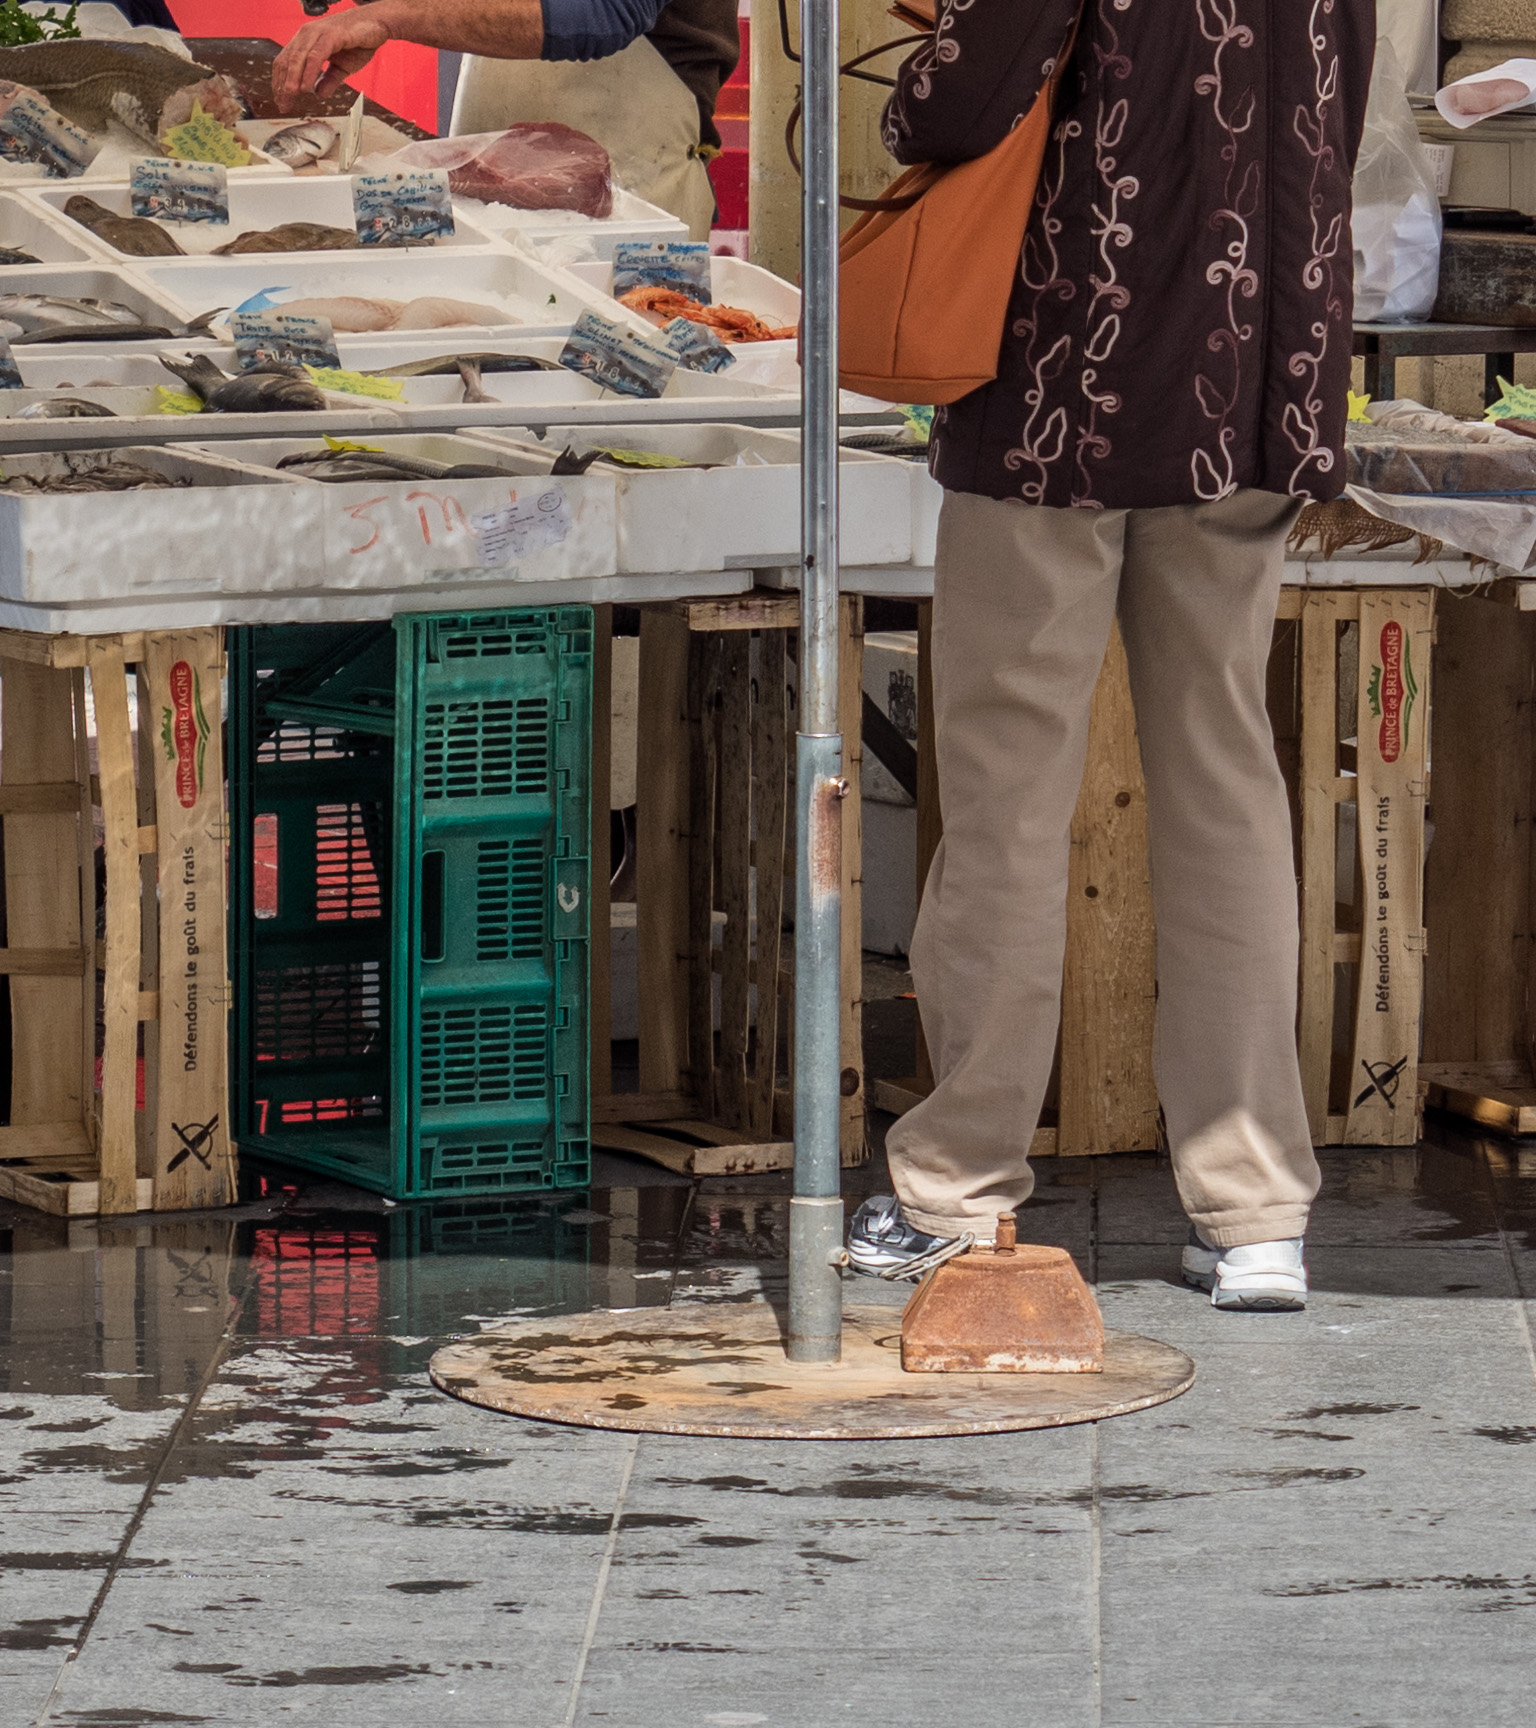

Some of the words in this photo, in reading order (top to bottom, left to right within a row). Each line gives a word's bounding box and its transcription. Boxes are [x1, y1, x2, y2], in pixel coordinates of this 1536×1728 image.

[1386, 628, 1399, 696] BRETAGNE
[176, 668, 191, 739] BRETAGNE
[1387, 696, 1399, 710] de
[1384, 711, 1396, 756] PRINCE
[182, 757, 193, 802] PRINCE
[1376, 796, 1390, 832] frais
[182, 845, 196, 886] frais
[1376, 838, 1388, 858] du
[1376, 864, 1390, 900] goût
[183, 891, 197, 913] du
[1377, 905, 1388, 922] le
[183, 918, 200, 956] goût
[185, 960, 198, 979] le
[1375, 926, 1390, 1013] Défendons
[184, 983, 198, 1072] Défendons
